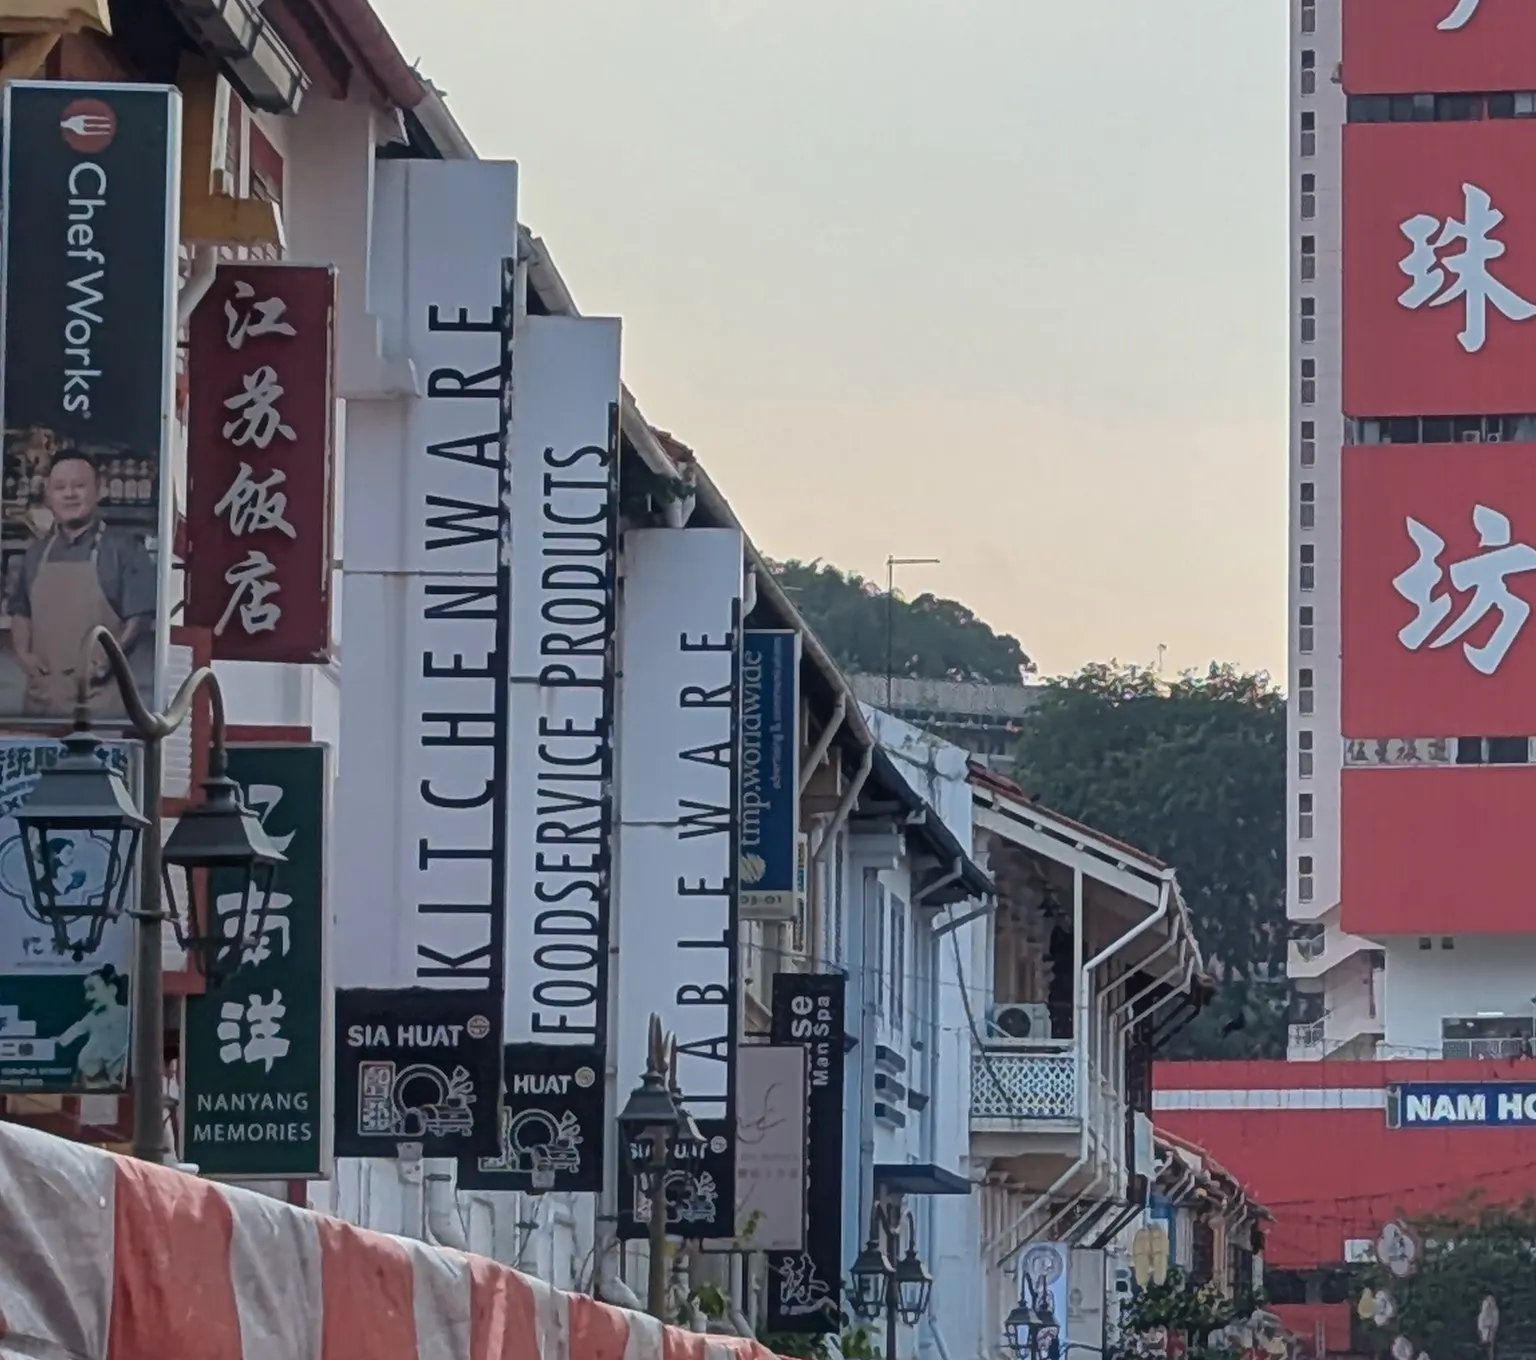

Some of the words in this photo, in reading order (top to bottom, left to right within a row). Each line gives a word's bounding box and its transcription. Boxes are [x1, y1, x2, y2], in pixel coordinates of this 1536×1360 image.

[67, 161, 107, 264] Chef
[62, 272, 104, 414] Works
[213, 280, 298, 636] 江苏饭店
[537, 444, 611, 687] PRODUCTS
[416, 304, 503, 979] KITCHENWARE
[740, 650, 771, 847] tmp.worldwide
[530, 714, 605, 1035] FOODSERVICE
[676, 630, 735, 1107] TABLEWARE
[347, 1024, 391, 1048] SIA
[397, 1024, 464, 1047] HUAT
[811, 995, 832, 1037] Spa
[812, 1042, 830, 1087] Man
[193, 1121, 312, 1143] MEMORIES
[196, 1092, 309, 1112] NANYANG
[513, 1074, 572, 1095] HUAT
[1406, 1093, 1487, 1121] NAM
